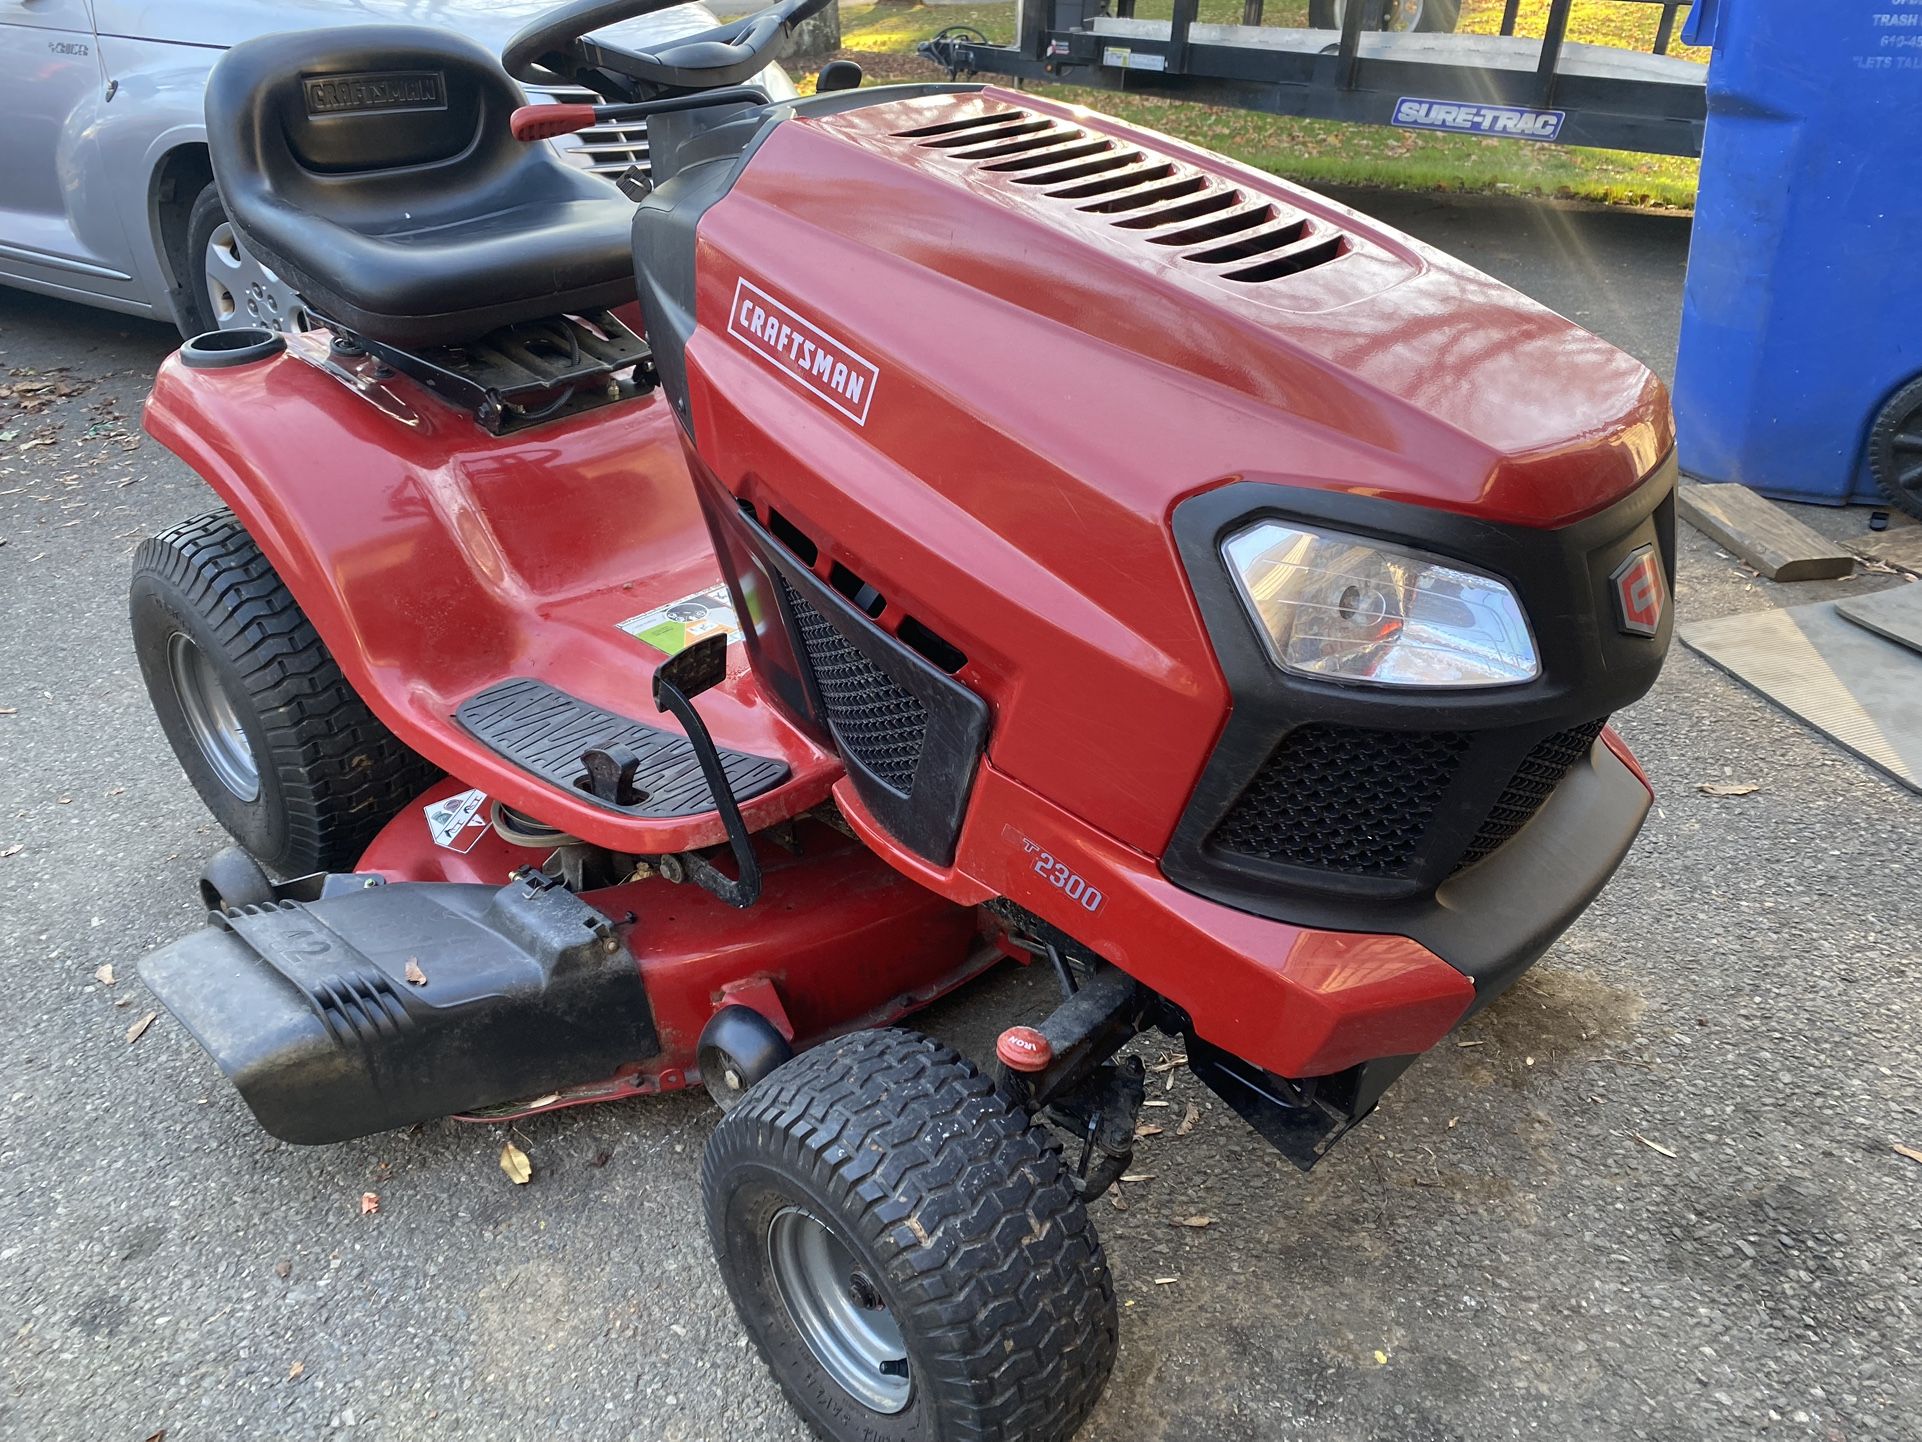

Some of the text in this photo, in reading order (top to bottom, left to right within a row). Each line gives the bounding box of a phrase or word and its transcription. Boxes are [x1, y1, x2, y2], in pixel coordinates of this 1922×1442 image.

[1872, 14, 1919, 27] TRASH
[1398, 101, 1558, 136] SURE-TRAC
[739, 299, 864, 404] CRAFTSMAN
